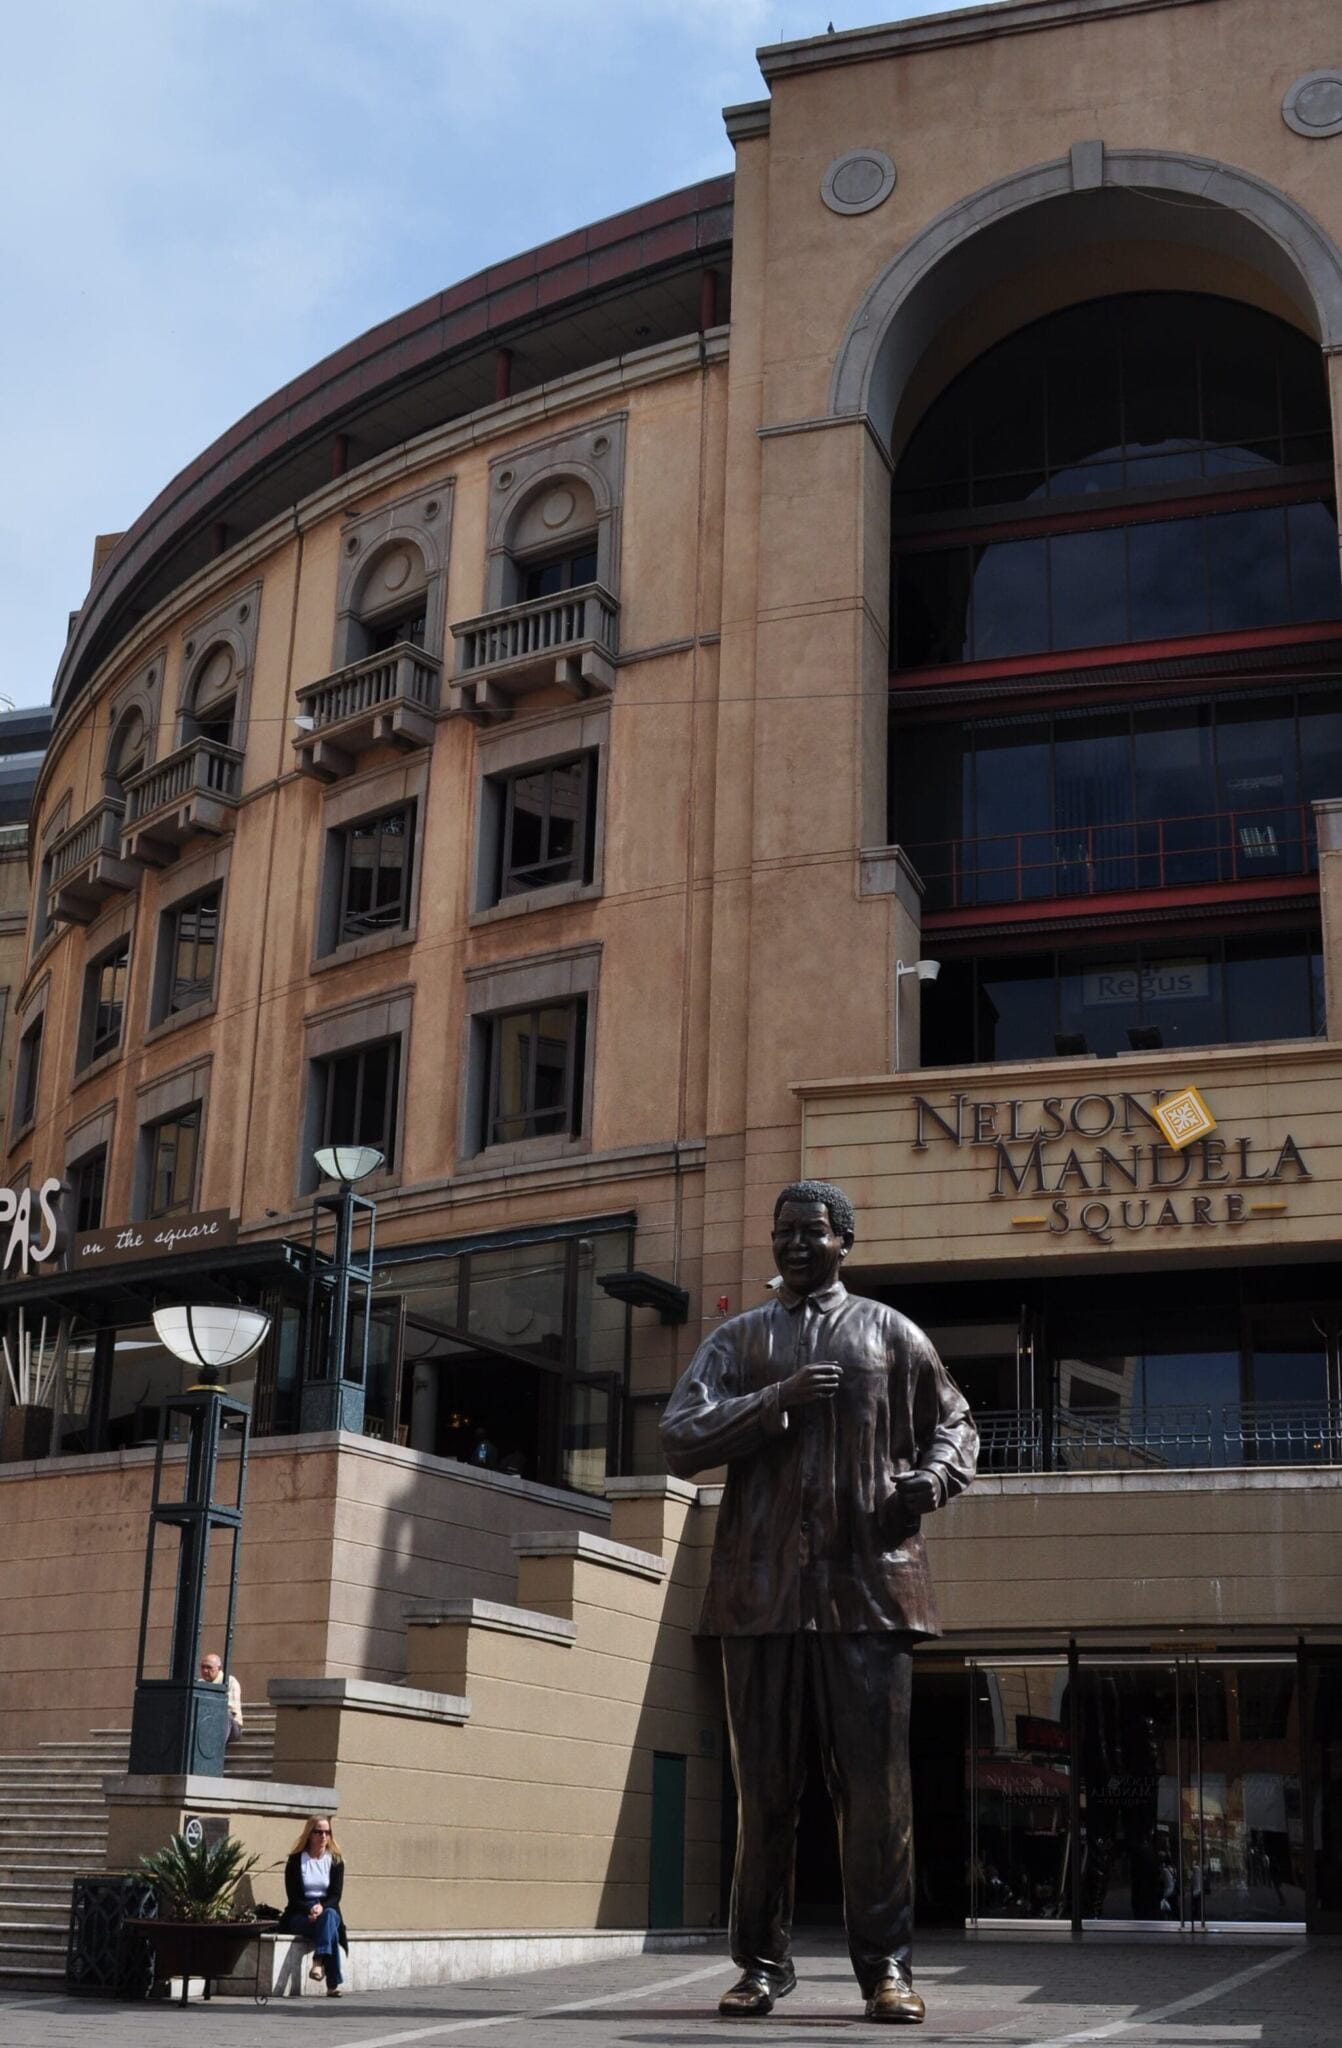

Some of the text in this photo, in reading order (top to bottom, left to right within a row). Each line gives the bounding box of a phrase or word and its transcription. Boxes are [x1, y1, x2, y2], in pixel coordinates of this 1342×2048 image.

[1098, 975, 1193, 999] Regus
[911, 1089, 1167, 1149] NELSON
[989, 1134, 1312, 1197] MANDELA
[82, 1222, 220, 1256] on the square
[1049, 1194, 1248, 1244] SQUARE
